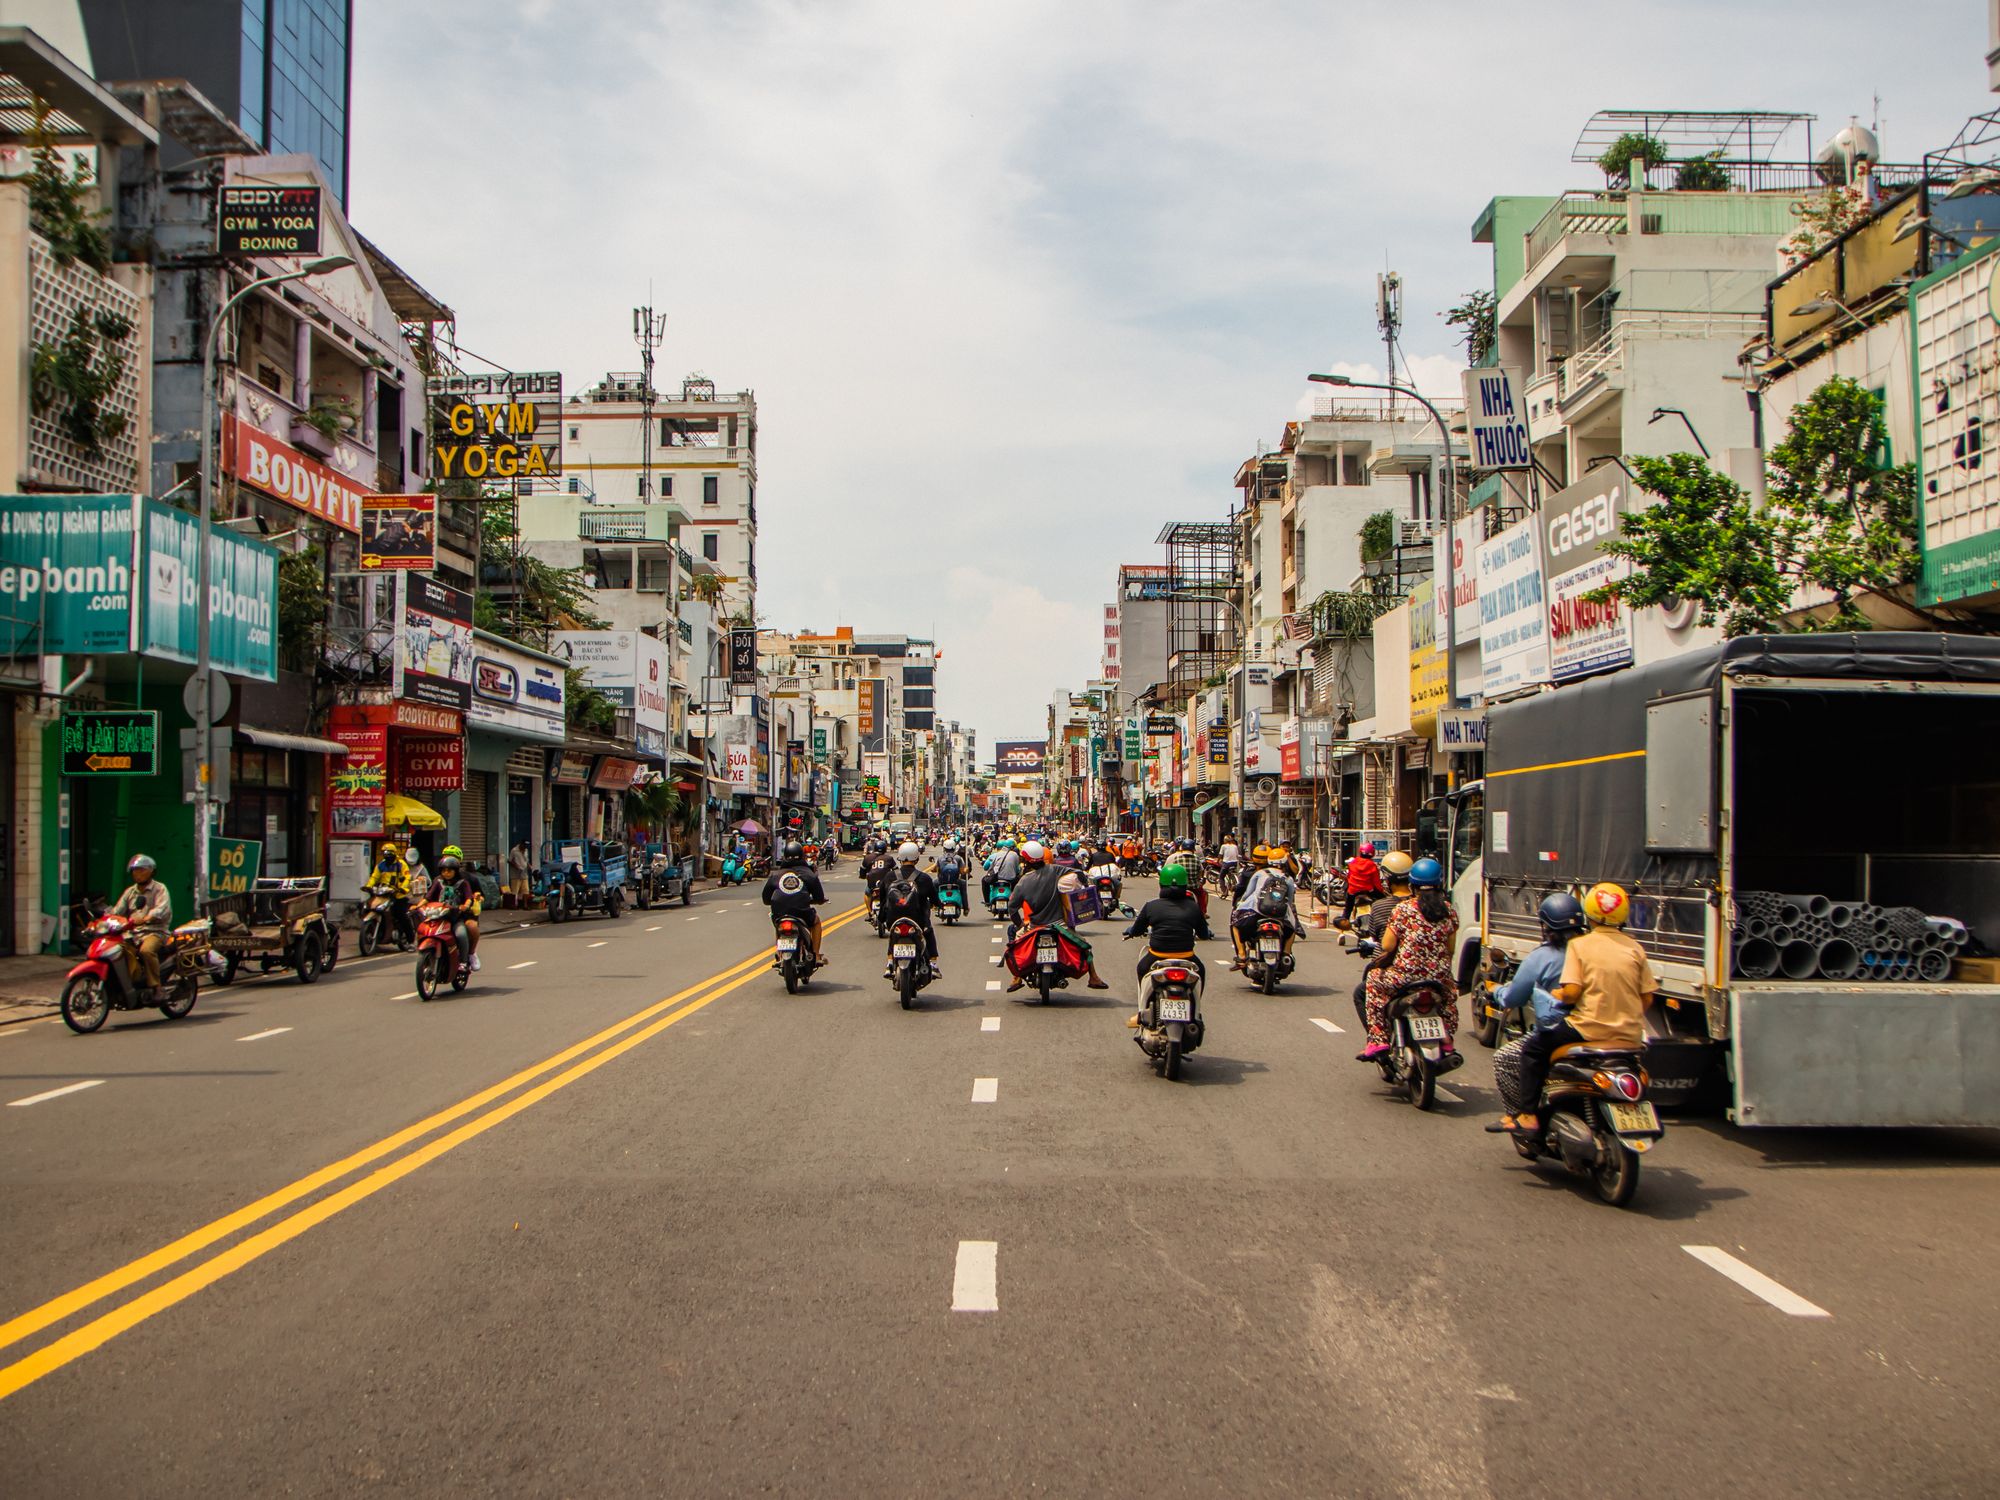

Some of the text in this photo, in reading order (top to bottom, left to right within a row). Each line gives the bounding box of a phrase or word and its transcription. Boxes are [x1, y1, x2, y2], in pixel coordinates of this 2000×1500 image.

[225, 190, 315, 204] BODYFIT
[224, 217, 258, 230] GYM
[272, 217, 315, 230] YOGA
[240, 237, 298, 250] BOXING
[1480, 369, 1514, 416] NHÀ
[450, 401, 535, 436] GYM
[1474, 416, 1527, 465] THUỐC
[436, 444, 548, 478] YOGA
[248, 440, 362, 529] BODYFIT
[13, 511, 43, 537] DỤNG
[44, 511, 60, 537] CỤ
[62, 505, 99, 534] NGÀNH
[102, 504, 132, 533] BÁNH
[87, 595, 127, 611] .com
[182, 565, 271, 628] bpbanh
[247, 627, 270, 647] .com
[1104, 625, 1119, 638] KHOA
[639, 683, 665, 713] Kymdan
[1302, 719, 1328, 732] THIẾT
[1443, 715, 1488, 743] NHÀ THUỐ
[337, 732, 381, 740] BODYFIT
[405, 739, 459, 753] PHÒNG
[411, 759, 454, 770] GYM
[728, 750, 748, 766] SỬA
[1007, 752, 1038, 767] PRO
[405, 777, 459, 787] BODYFIT
[732, 770, 744, 781] XE
[1649, 1078, 1698, 1088] ISUZU
